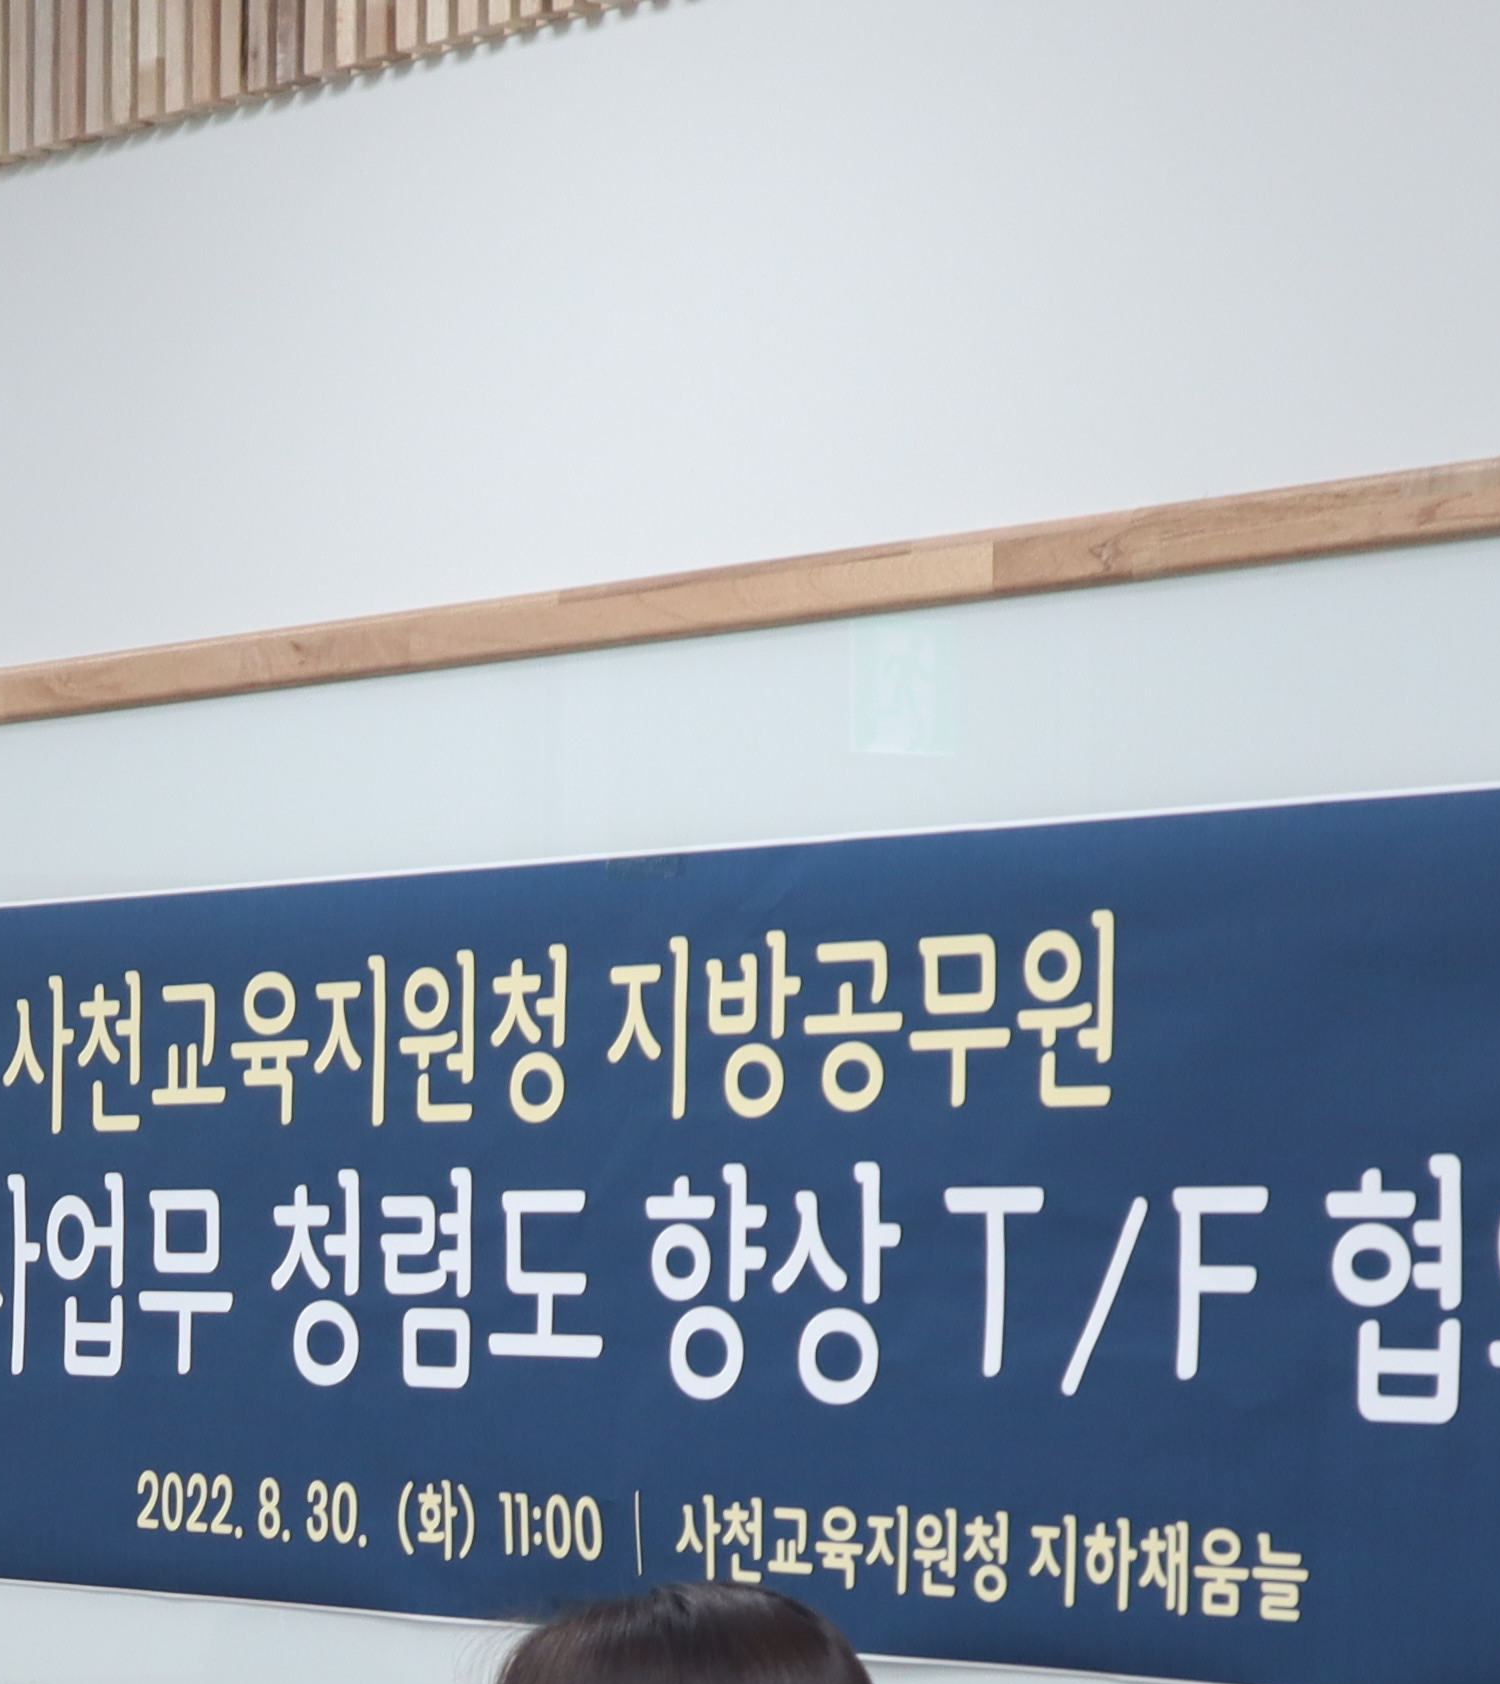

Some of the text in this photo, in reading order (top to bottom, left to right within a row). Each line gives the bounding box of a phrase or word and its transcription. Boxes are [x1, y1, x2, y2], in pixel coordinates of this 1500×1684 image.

[1, 908, 1115, 1136] 사천교육지원청 지방공무원
[269, 1166, 604, 1390] 청렴도
[644, 1160, 902, 1406] 향상
[943, 1185, 1270, 1397] T/F
[135, 1468, 603, 1562] 2022. 8. 30. (화) 11:00
[675, 1493, 1310, 1623] 사천교육지원청 지하채움늘
